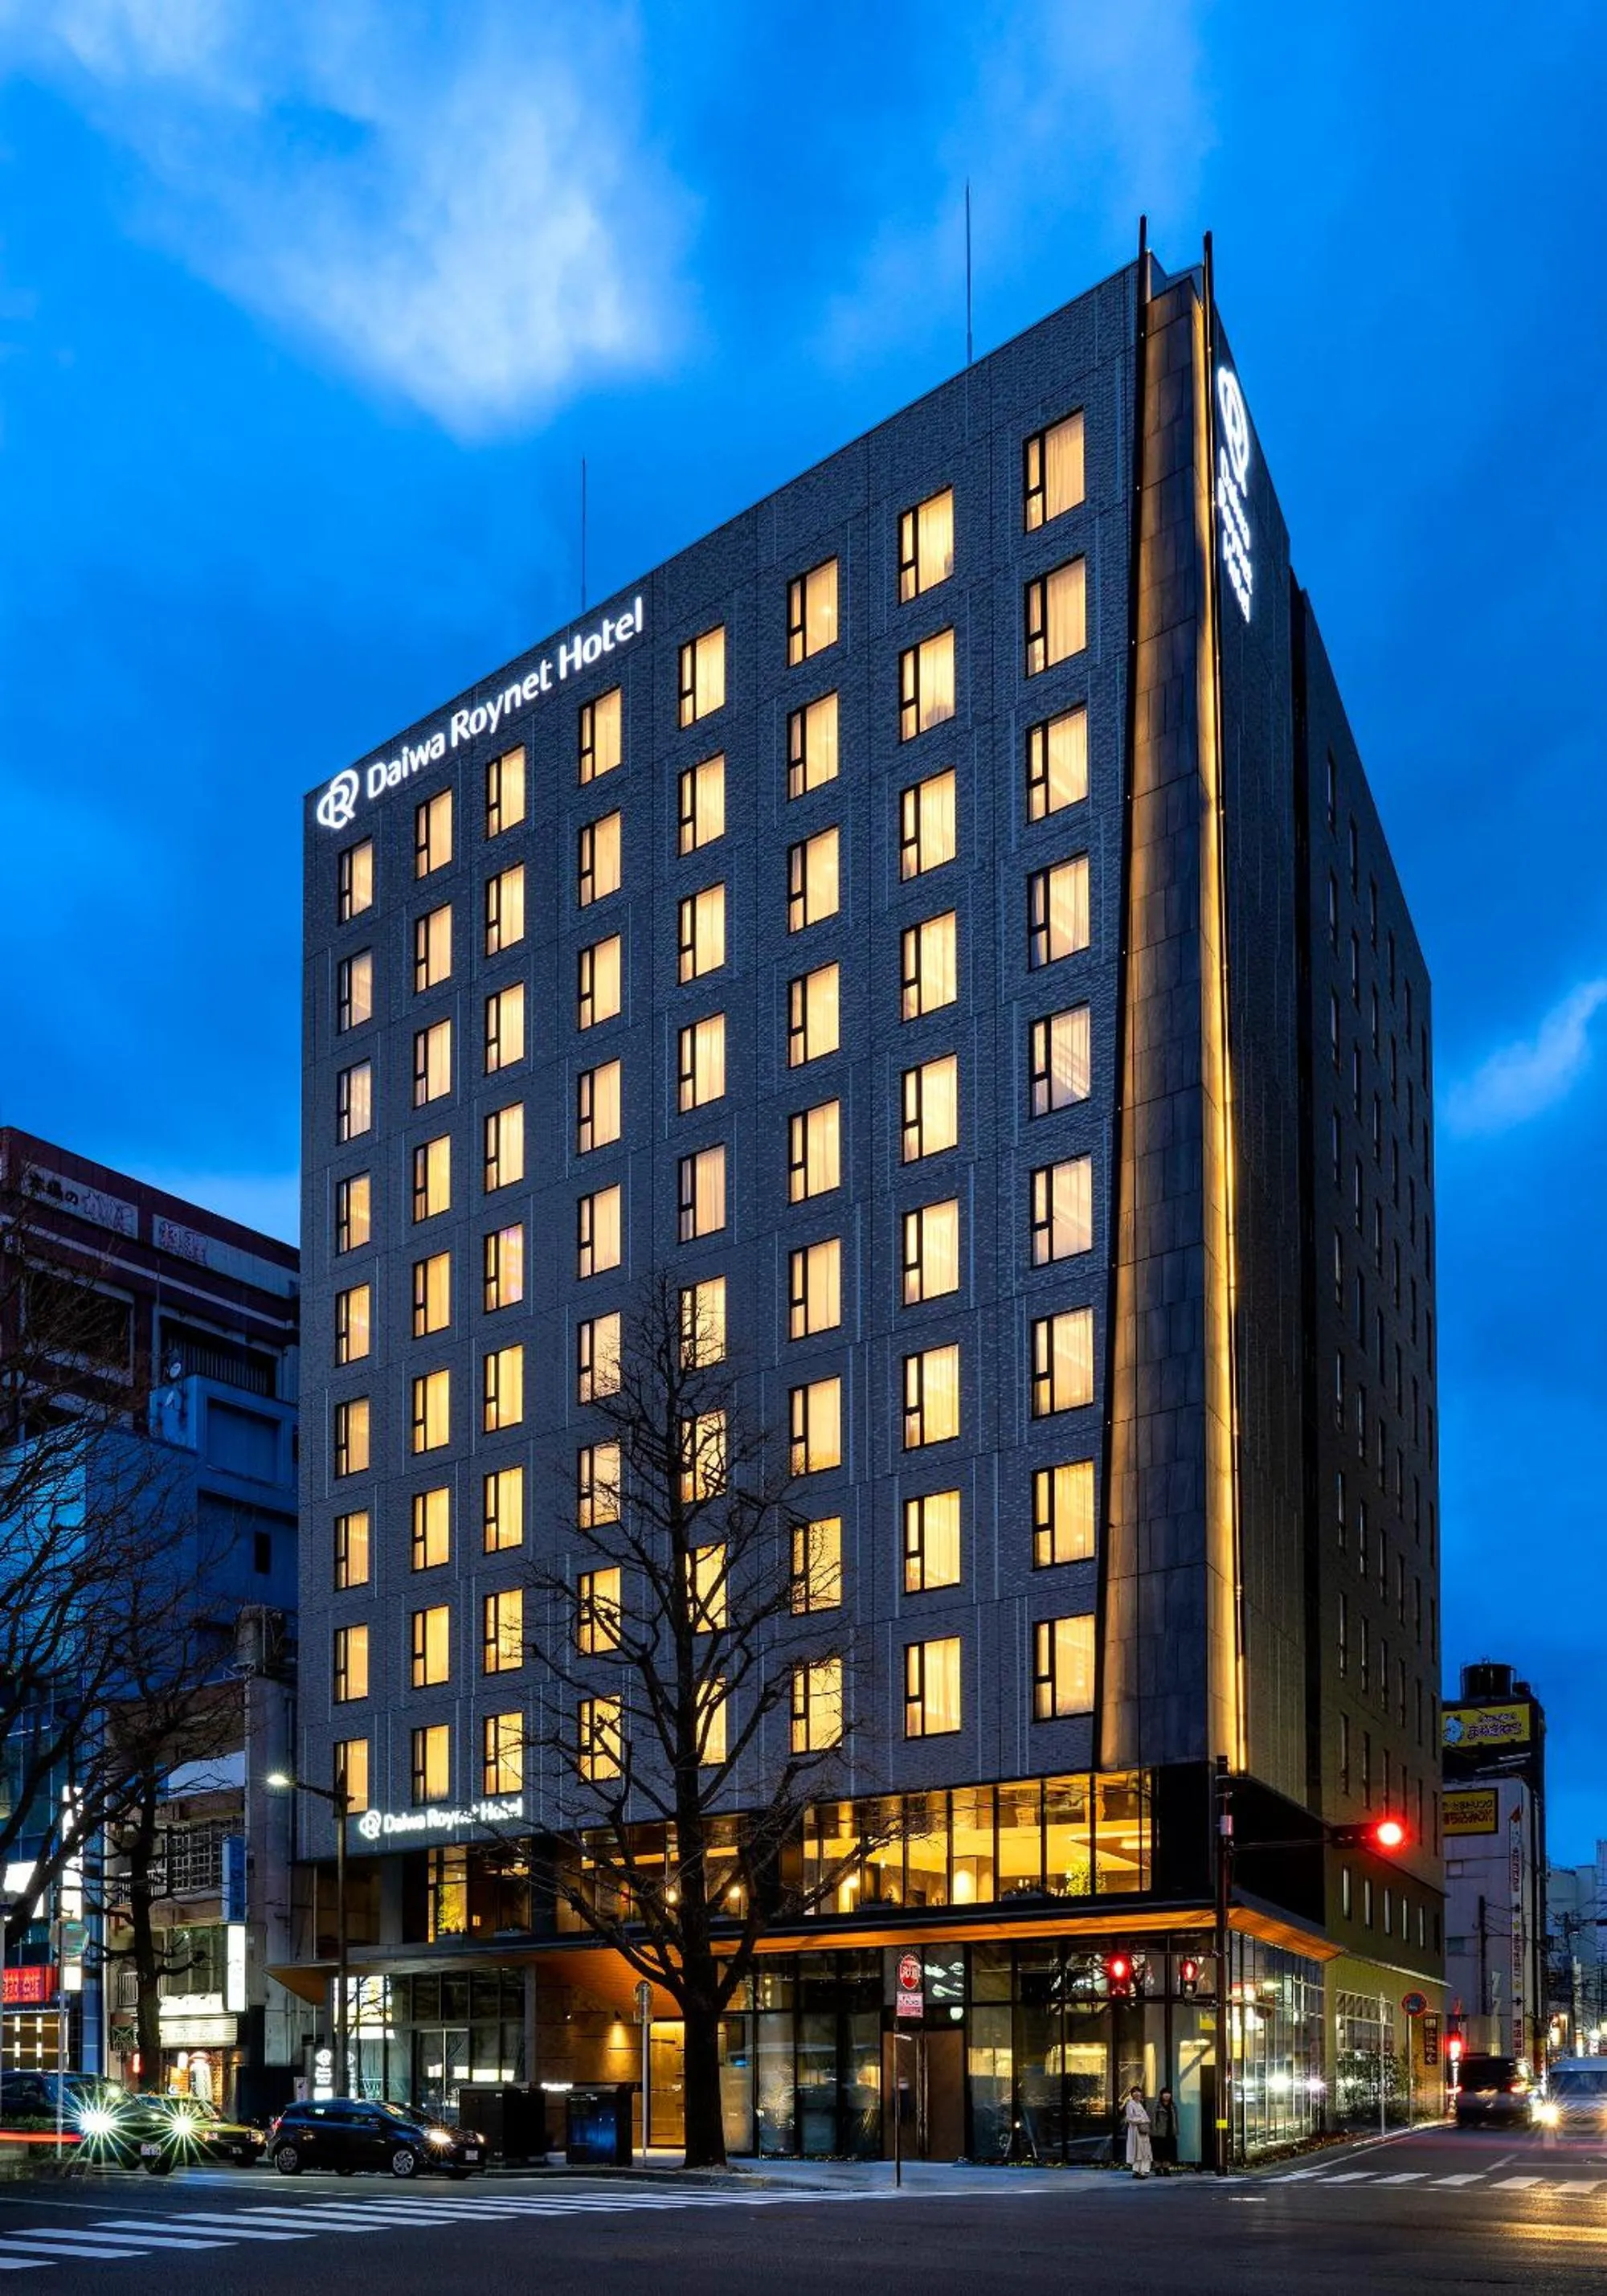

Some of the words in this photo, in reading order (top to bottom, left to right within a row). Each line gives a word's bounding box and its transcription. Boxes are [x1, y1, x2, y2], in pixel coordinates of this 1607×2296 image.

[367, 733, 445, 799] Daiwa
[450, 659, 552, 747] Roynet
[558, 596, 643, 680] Hotel
